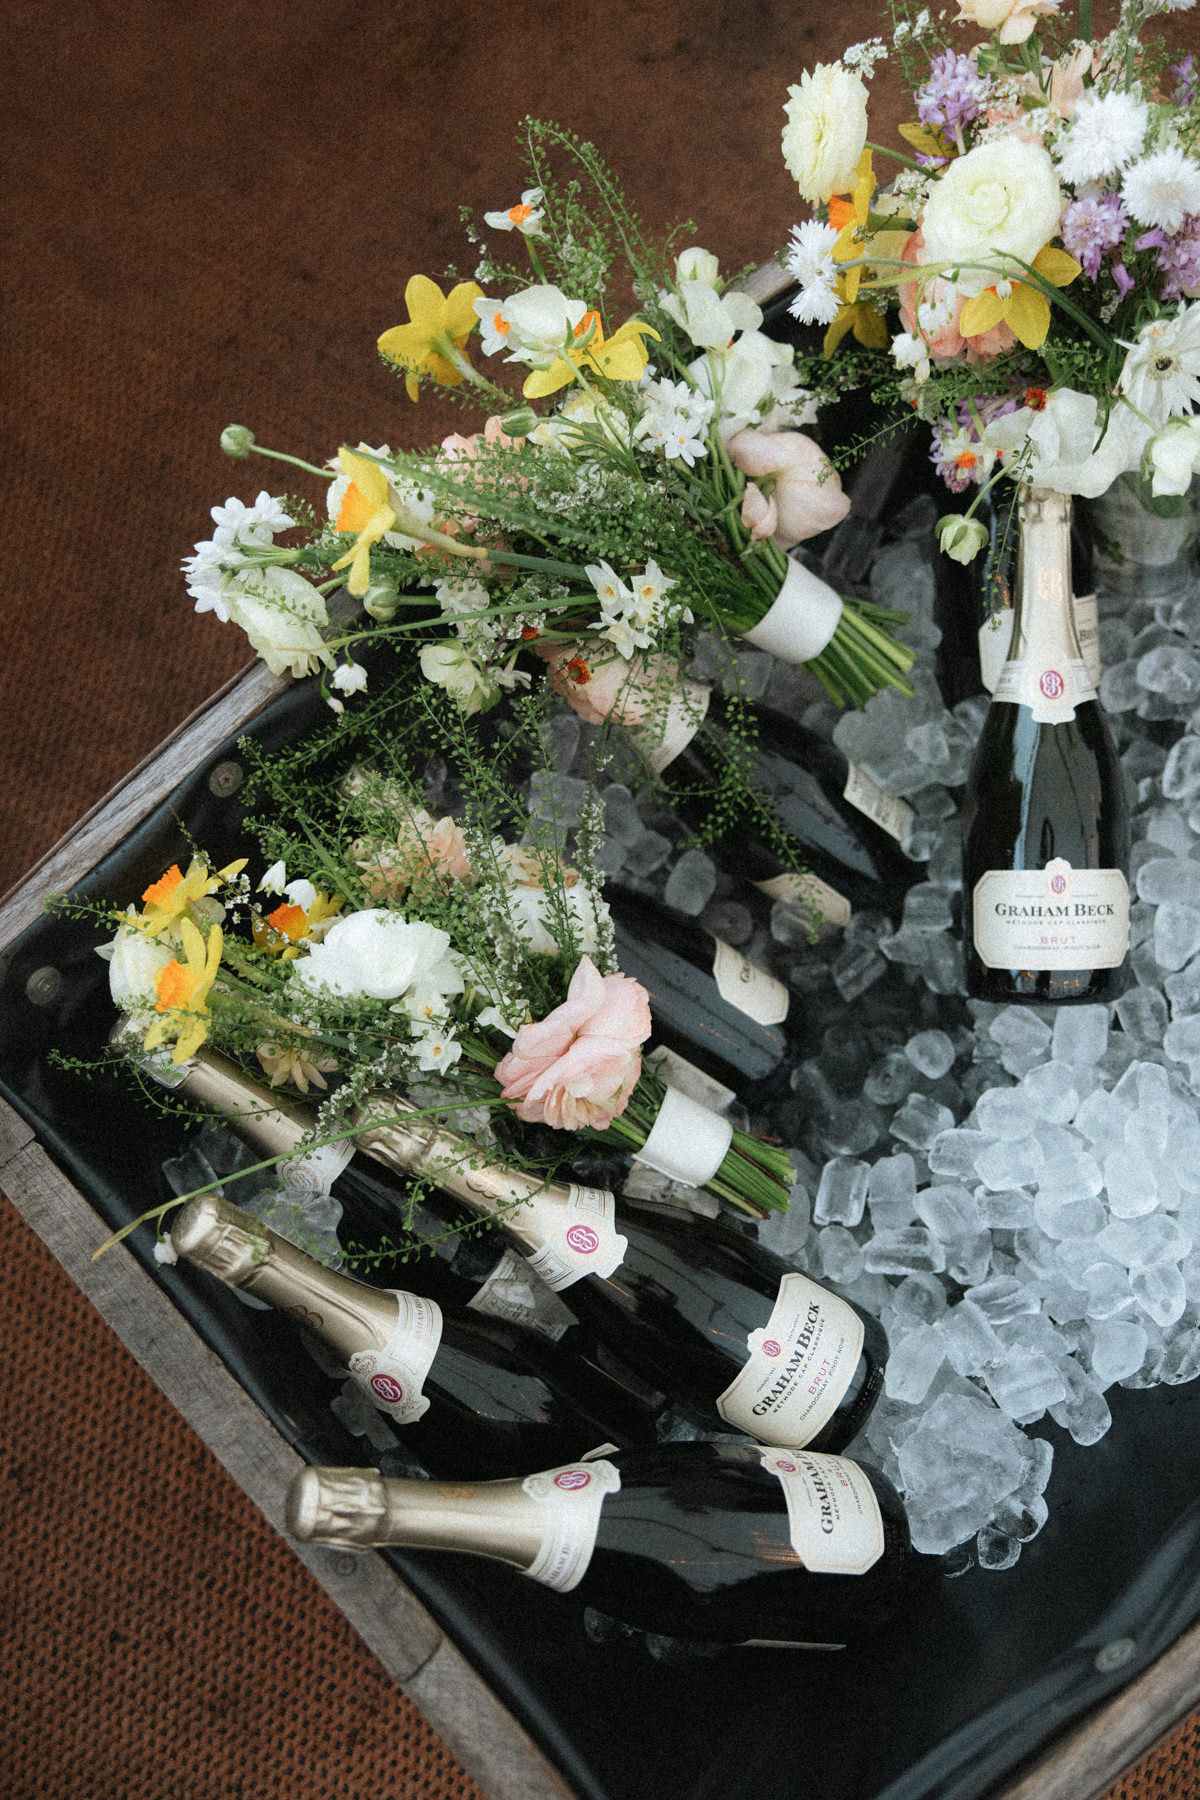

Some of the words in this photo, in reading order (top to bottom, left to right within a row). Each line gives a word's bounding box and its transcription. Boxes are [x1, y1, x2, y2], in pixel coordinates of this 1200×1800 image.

[994, 902, 1069, 917] GRAHAM
[1074, 903, 1114, 917] BECK
[1040, 936, 1076, 944] BRUT
[752, 1350, 804, 1416] GRAHAM
[796, 1300, 820, 1350] BECK
[798, 1363, 808, 1379] CAP
[808, 1358, 830, 1395] BRUT
[799, 1379, 829, 1421] CHARDONNAY
[828, 1355, 840, 1377] PINOT
[801, 1461, 834, 1534] GRAHAM
